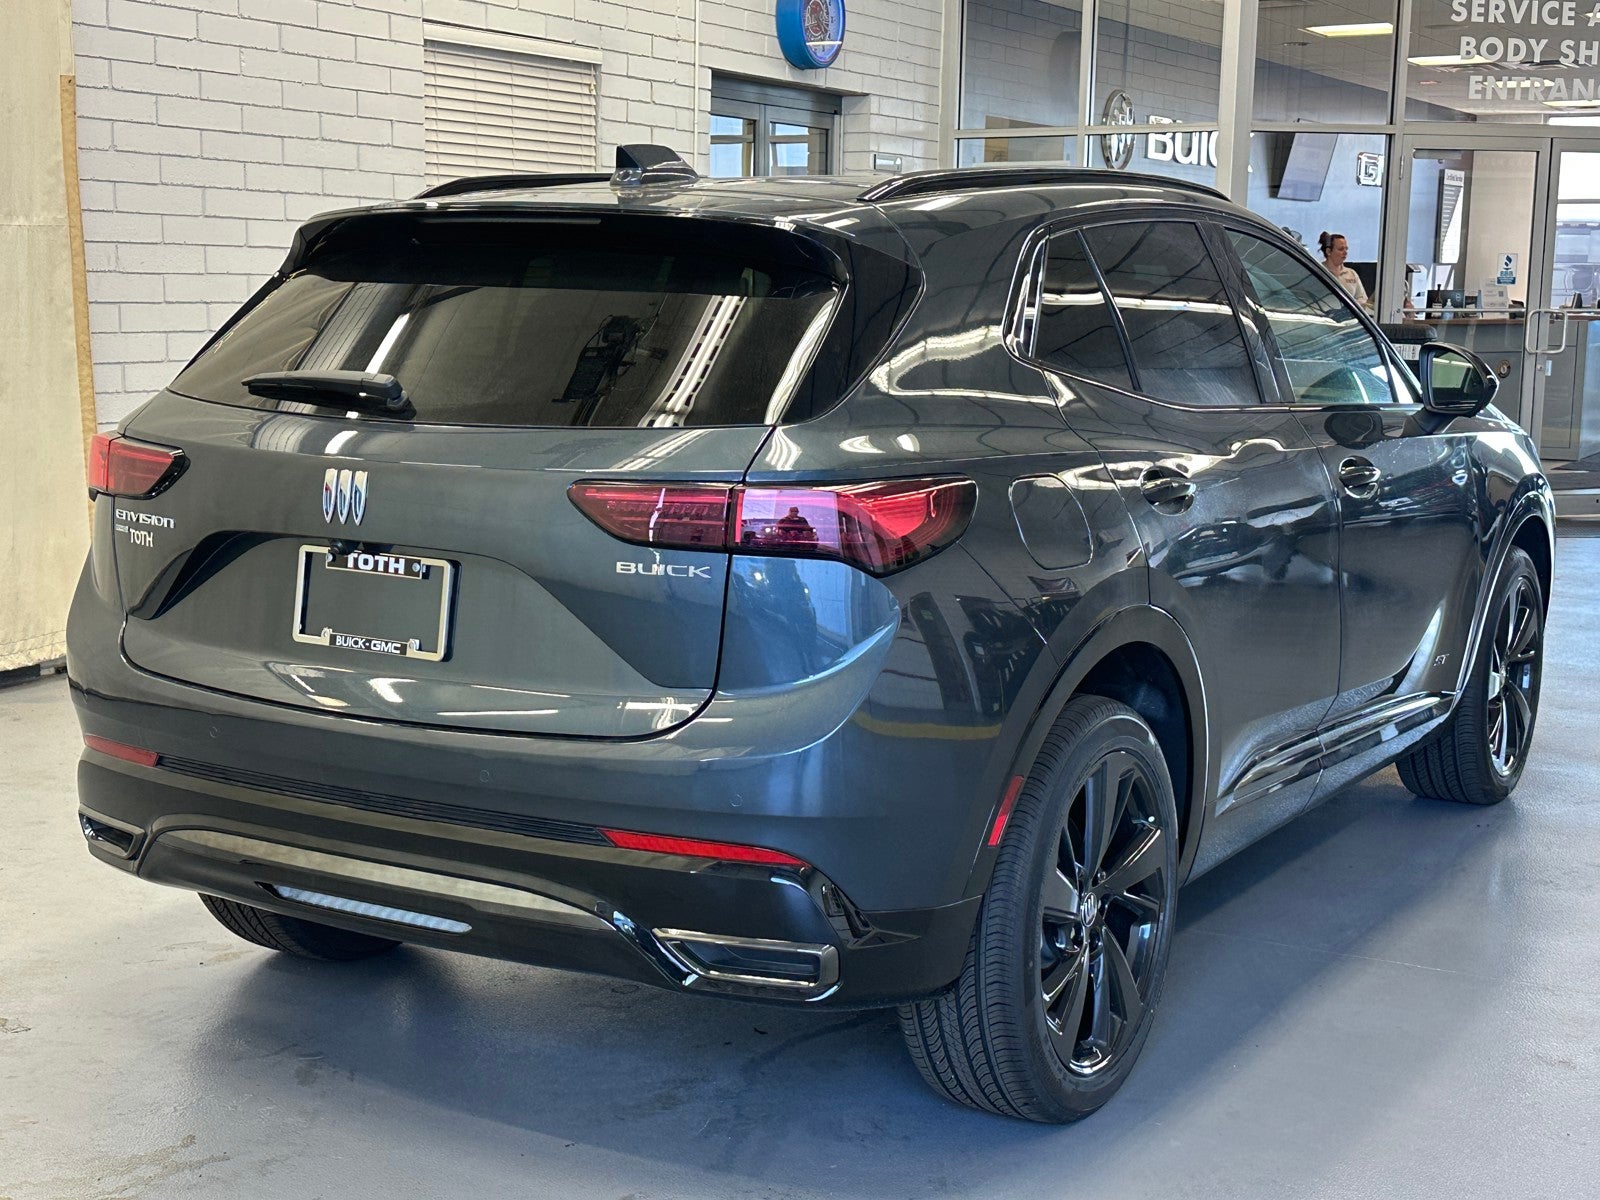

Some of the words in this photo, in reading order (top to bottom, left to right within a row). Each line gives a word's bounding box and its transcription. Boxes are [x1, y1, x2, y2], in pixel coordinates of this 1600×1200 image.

[1450, 0, 1577, 26] SERVICE
[1459, 36, 1549, 63] BODY
[1559, 39, 1599, 65] SH
[1468, 75, 1600, 101] ENTRAN
[115, 508, 175, 529] ENVISION
[129, 528, 154, 547] TOTH
[344, 552, 406, 575] TOTH
[615, 561, 712, 579] BUICK
